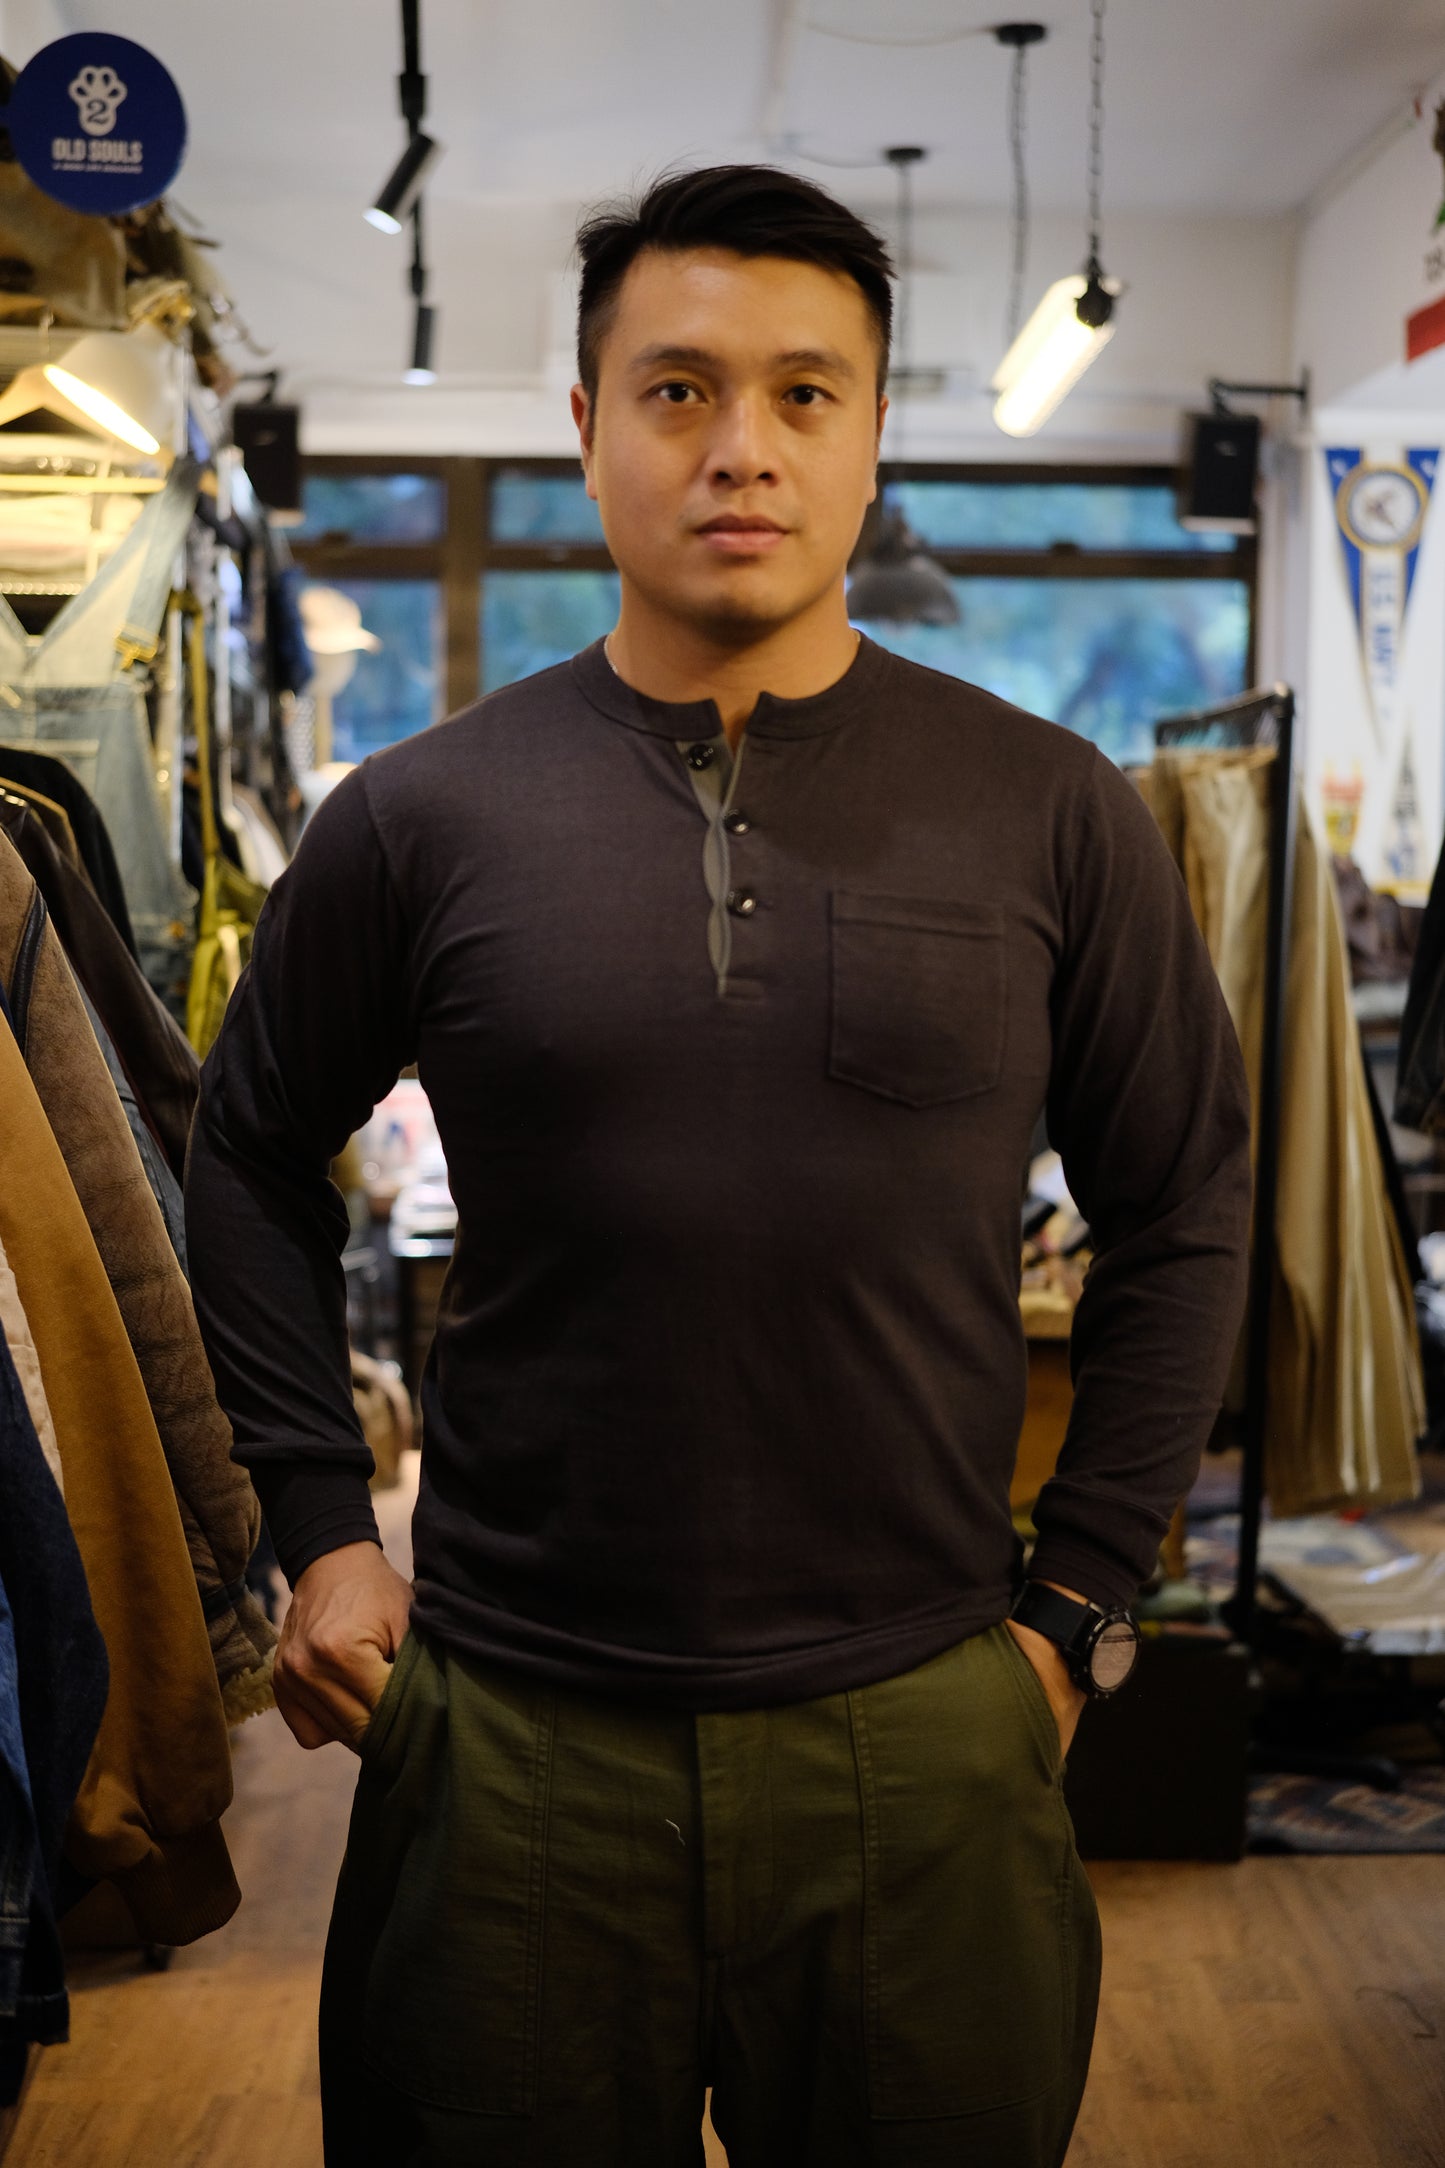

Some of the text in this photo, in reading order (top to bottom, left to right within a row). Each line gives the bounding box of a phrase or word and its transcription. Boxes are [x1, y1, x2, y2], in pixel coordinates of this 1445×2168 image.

[87, 100, 109, 124] 2
[52, 138, 143, 164] OLD SOULS
